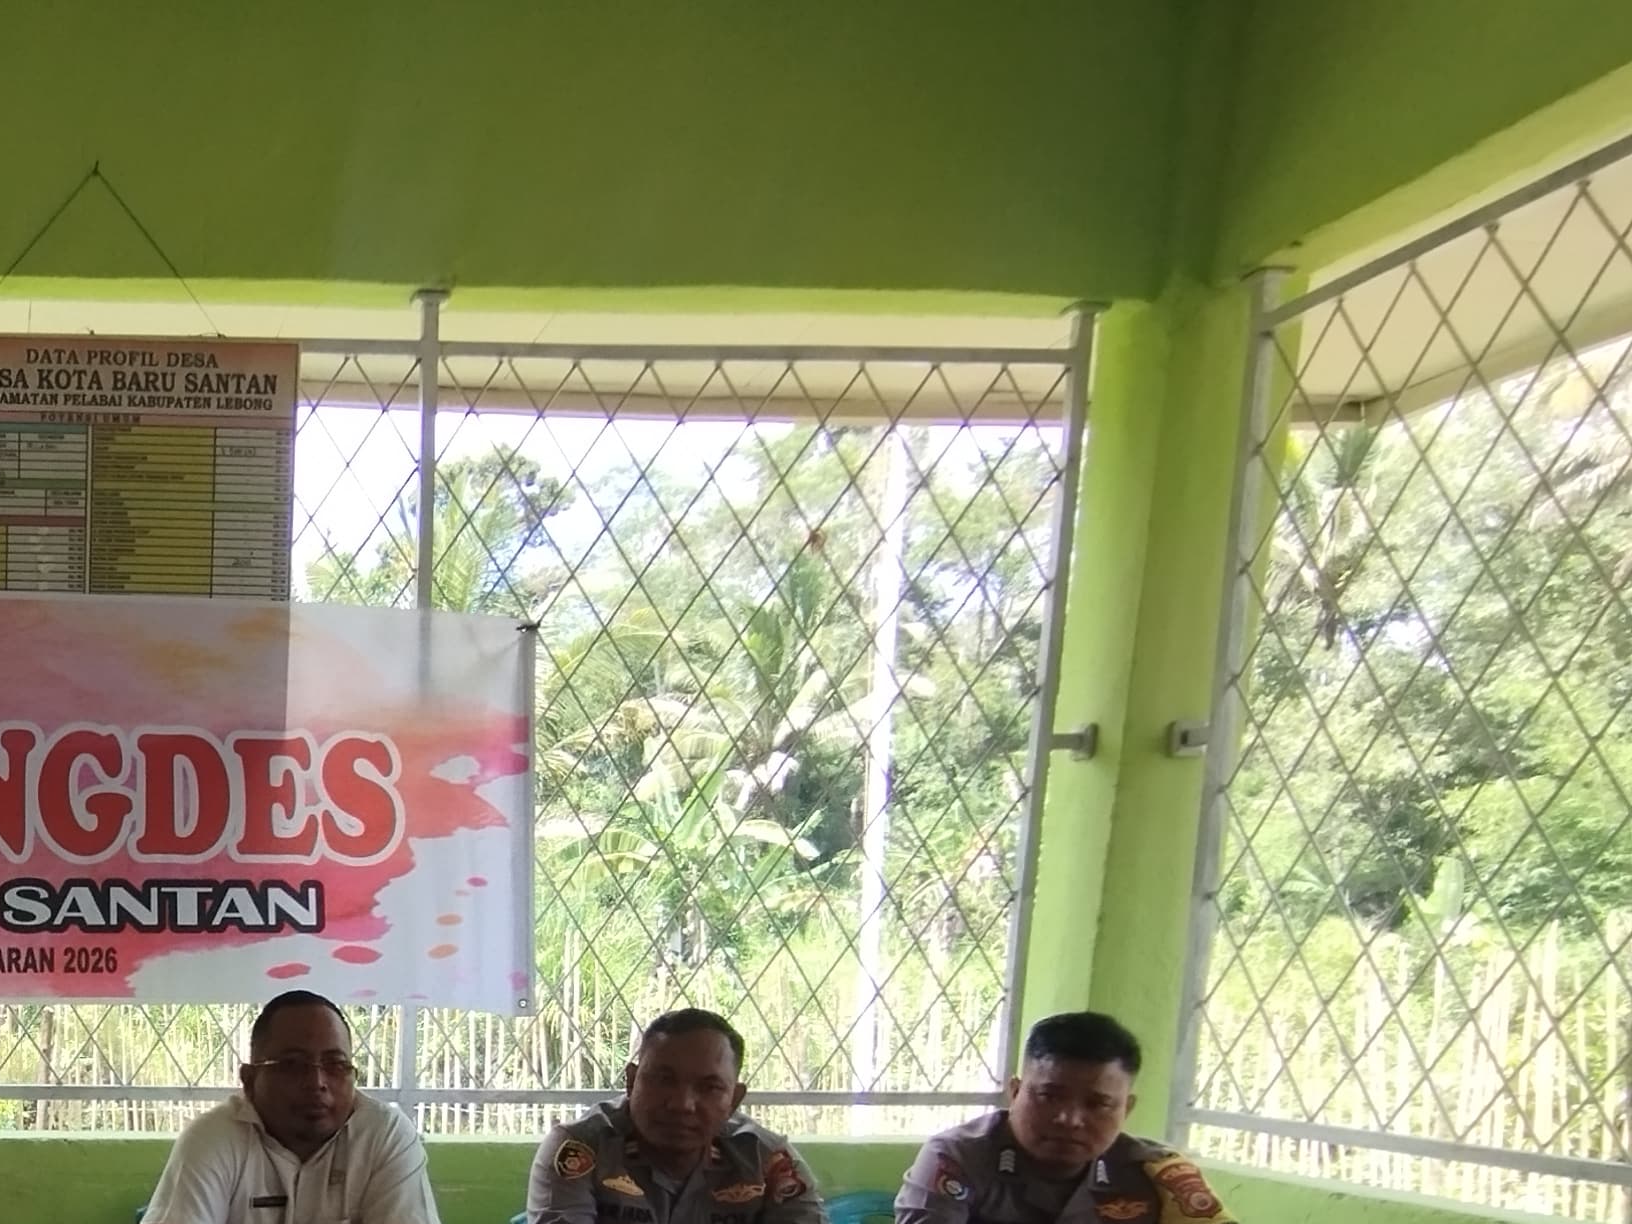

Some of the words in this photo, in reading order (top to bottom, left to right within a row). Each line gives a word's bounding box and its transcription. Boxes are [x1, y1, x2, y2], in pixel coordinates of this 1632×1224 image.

[25, 349, 79, 364] DATA
[86, 350, 159, 367] PROFIL
[166, 352, 219, 368] DESA
[37, 369, 103, 390] KOTA
[112, 370, 177, 393] BARU
[184, 372, 278, 395] SANTAN
[64, 393, 122, 407] PELABAI
[127, 394, 212, 409] KABUPATEN
[216, 396, 273, 411] LEBONG
[102, 414, 141, 424] UMUM
[3, 878, 324, 934] SANTAN
[63, 947, 118, 973] 2026
